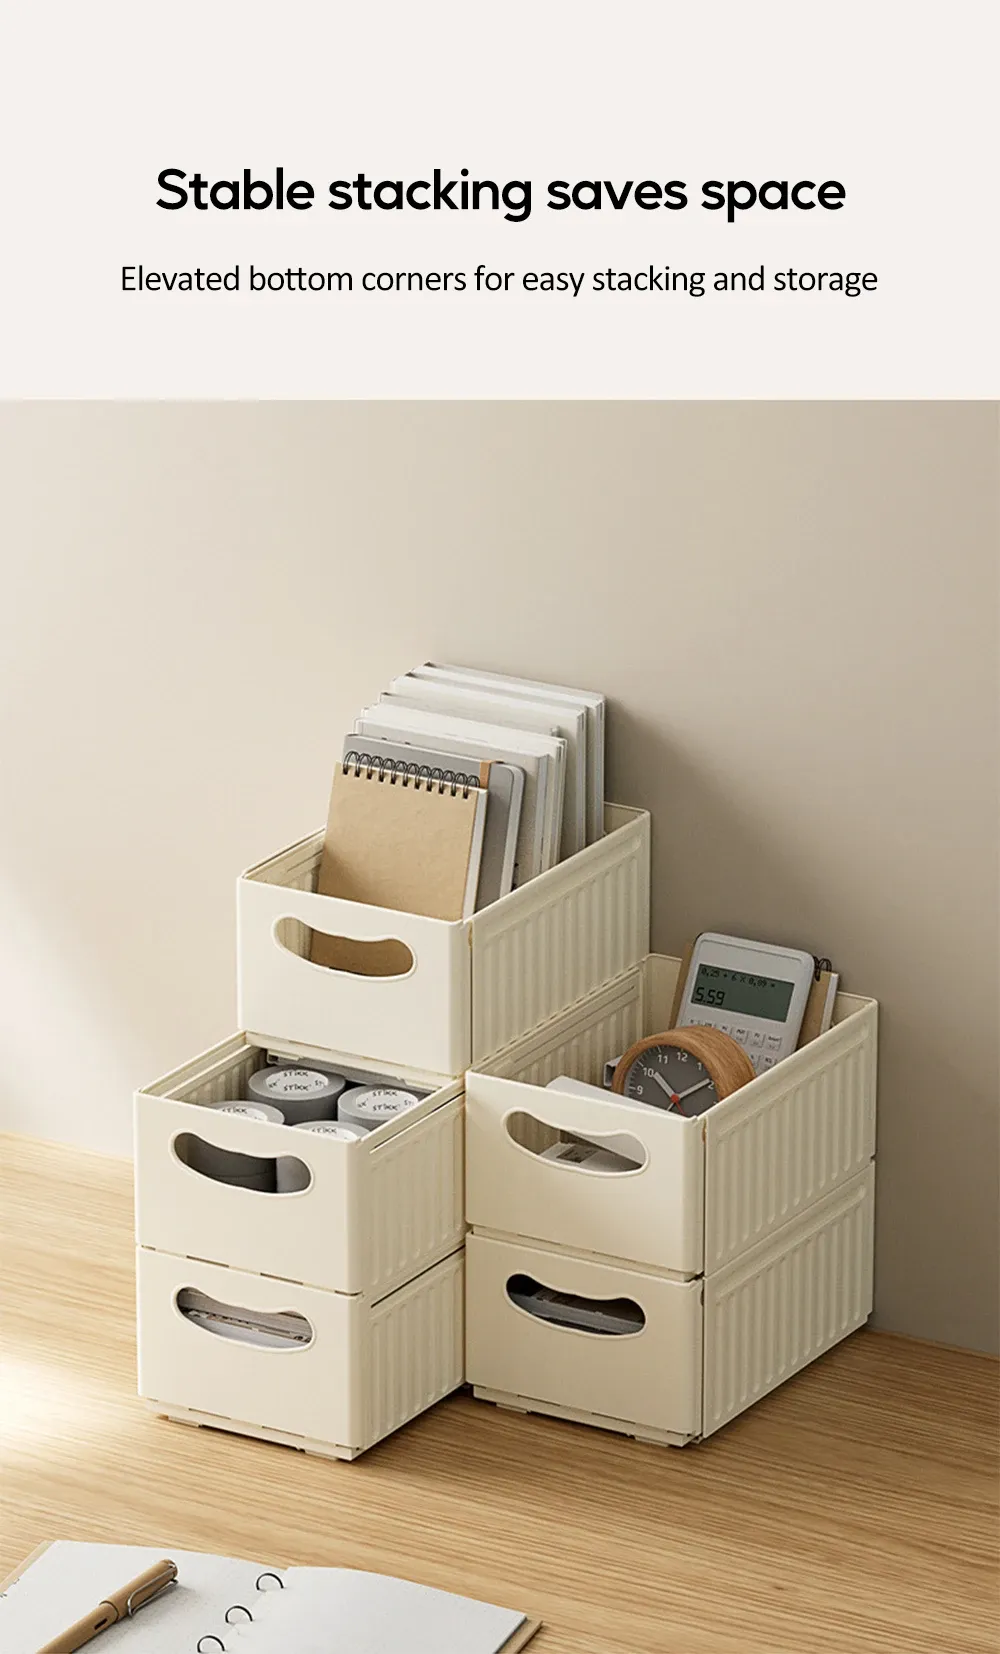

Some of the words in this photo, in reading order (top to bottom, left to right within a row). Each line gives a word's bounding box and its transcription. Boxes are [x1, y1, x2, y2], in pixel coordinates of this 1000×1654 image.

[694, 986, 726, 1006] 5.59
[658, 1054, 668, 1064] 11
[676, 1052, 688, 1062] 12
[697, 1062, 702, 1070] 1
[643, 1067, 654, 1077] 10
[636, 1085, 644, 1095] 9
[707, 1081, 714, 1090] 2
